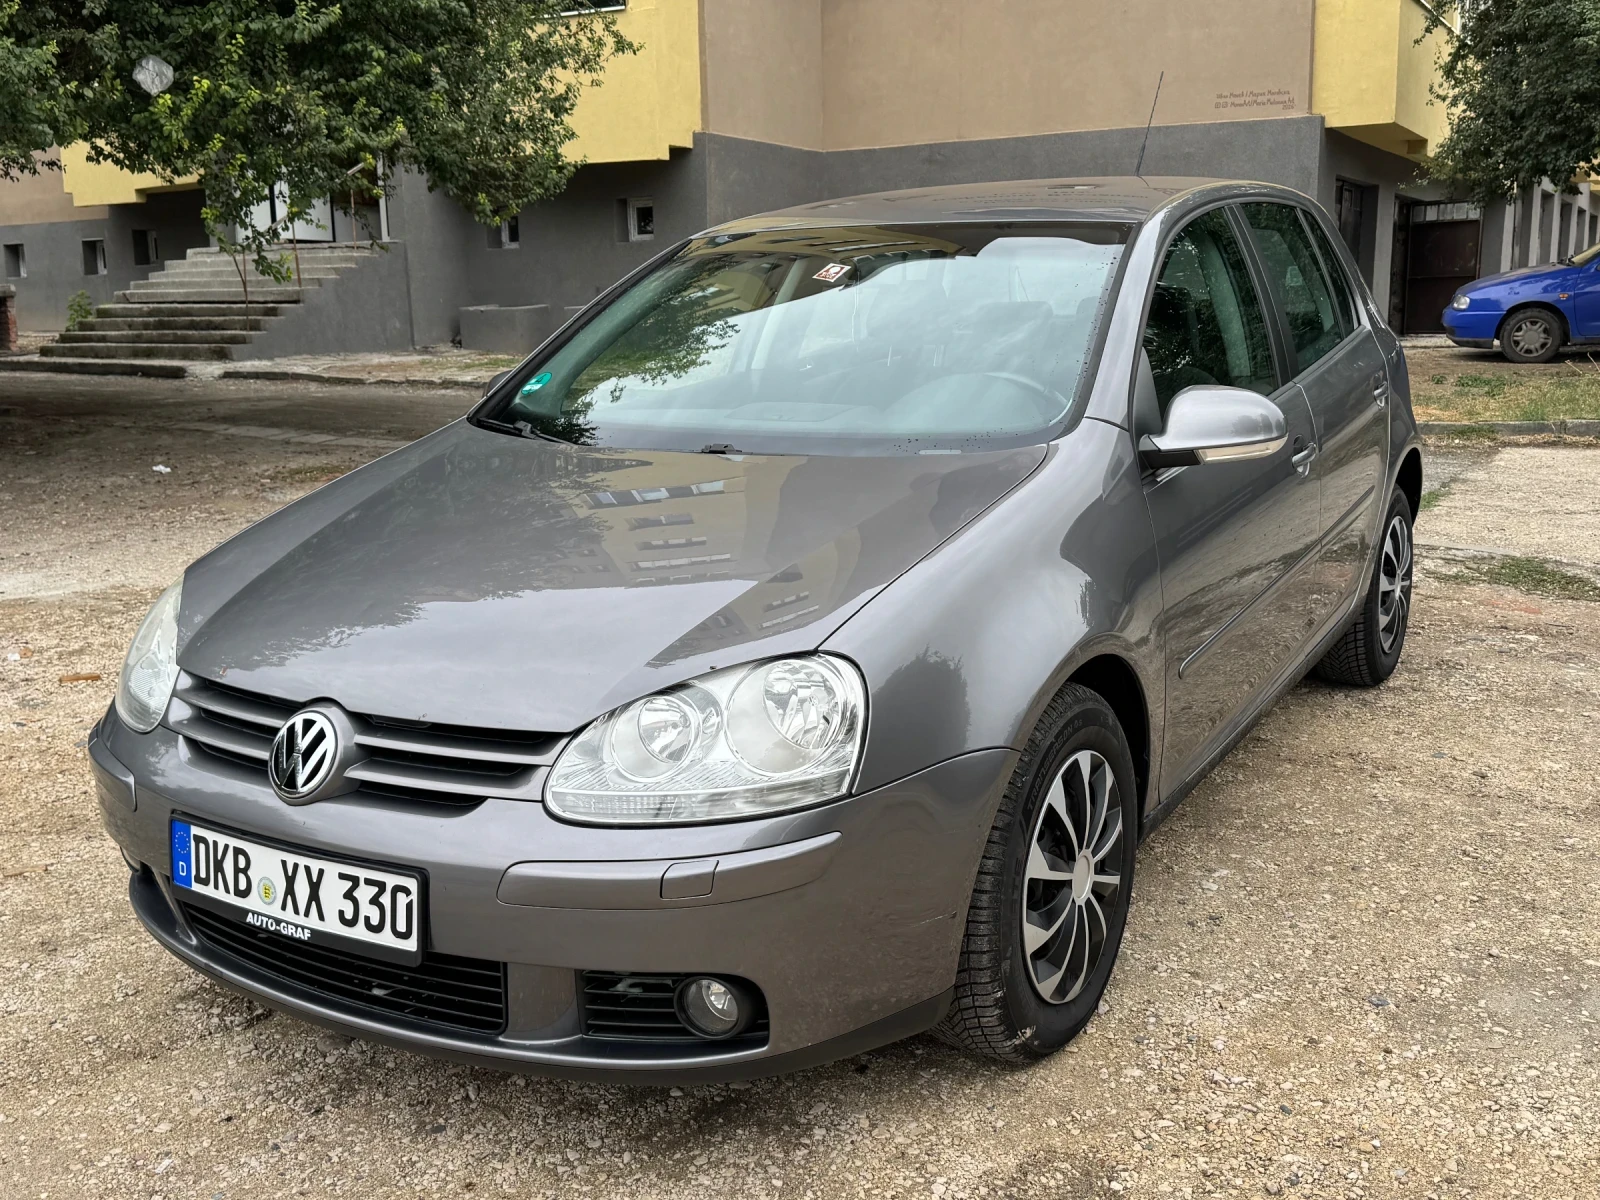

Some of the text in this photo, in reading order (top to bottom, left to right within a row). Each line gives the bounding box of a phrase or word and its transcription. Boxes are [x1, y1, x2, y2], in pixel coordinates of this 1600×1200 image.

[271, 711, 337, 794] VW
[179, 861, 187, 875] D
[192, 833, 413, 940] DKB XX 330
[245, 911, 312, 941] AUTO-GRAF
